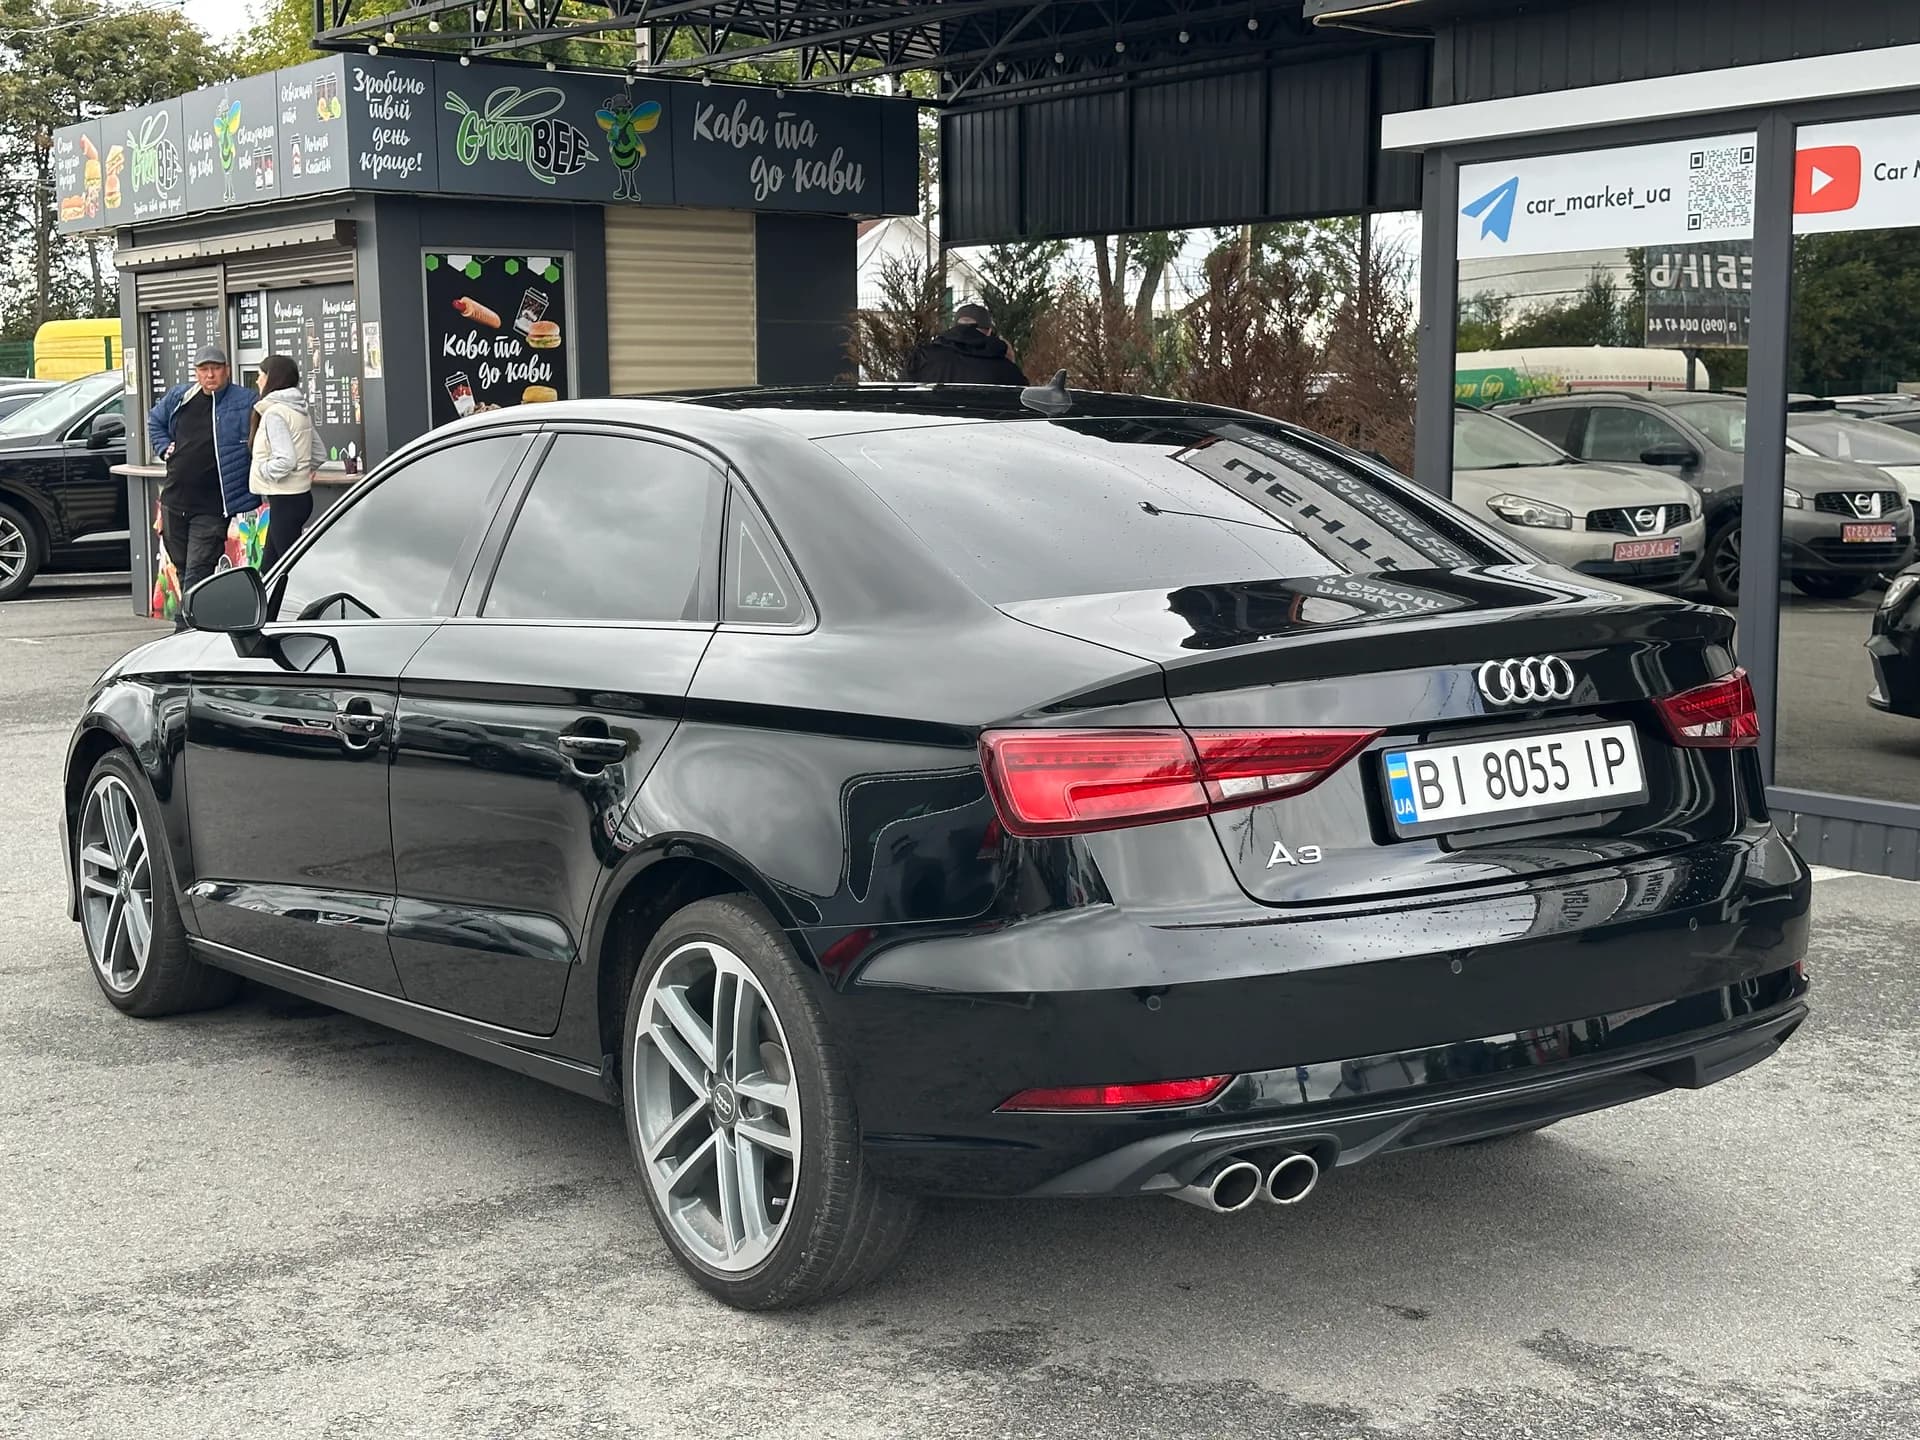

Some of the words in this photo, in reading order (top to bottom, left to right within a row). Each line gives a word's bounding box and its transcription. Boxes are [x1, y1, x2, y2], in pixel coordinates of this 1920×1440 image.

[353, 68, 425, 102] Зробимо
[369, 95, 412, 121] твій
[371, 126, 411, 151] день
[693, 98, 769, 149] Кава
[774, 111, 819, 151] та
[359, 152, 423, 180] краще!
[751, 155, 785, 201] до
[792, 146, 866, 195] кави
[1874, 162, 1908, 181] Car
[1526, 185, 1671, 217] car_market_ua
[443, 329, 491, 359] Кава
[493, 336, 522, 358] та
[478, 361, 501, 389] до
[505, 354, 552, 383] кави
[1414, 755, 1467, 811] BI
[1482, 742, 1570, 801] 8055
[1584, 736, 1626, 788] IP
[1395, 798, 1415, 815] UA
[1265, 840, 1322, 869] A3
